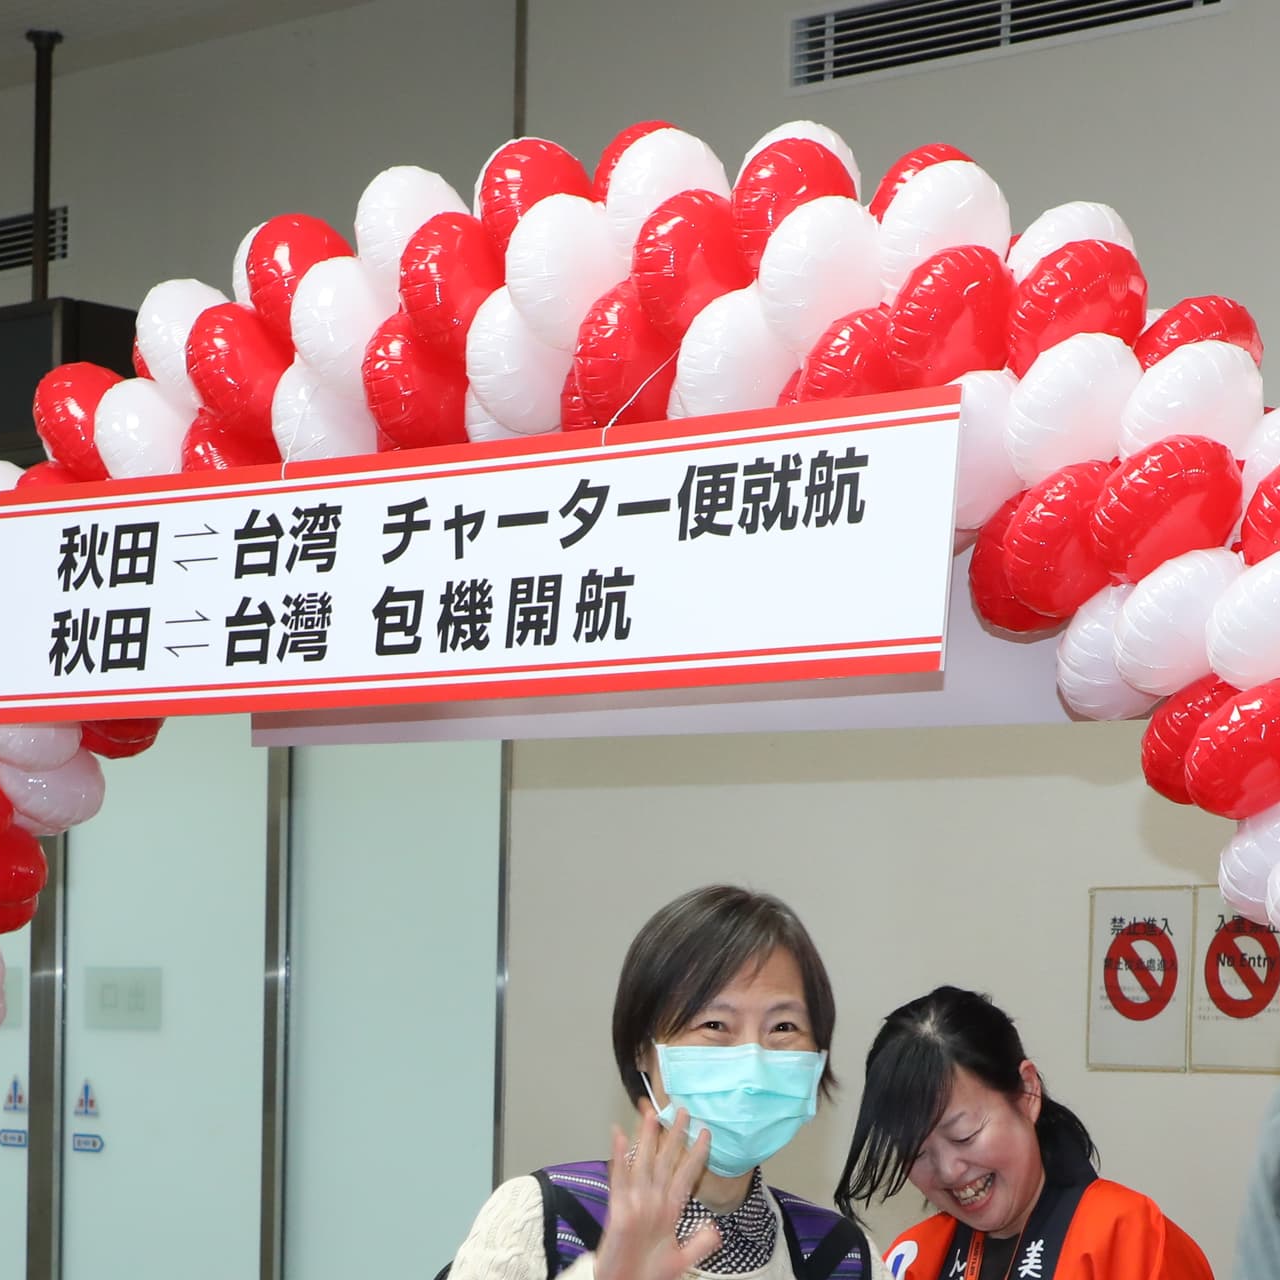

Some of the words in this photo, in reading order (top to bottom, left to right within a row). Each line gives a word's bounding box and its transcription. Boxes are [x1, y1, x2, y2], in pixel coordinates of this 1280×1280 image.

[56, 521, 159, 591] 秋田
[233, 503, 342, 580] 台湾
[382, 450, 870, 562] チャーター便就航
[48, 607, 151, 676] 秋田
[370, 568, 636, 657] 包機開航
[1239, 952, 1276, 972] Entry
